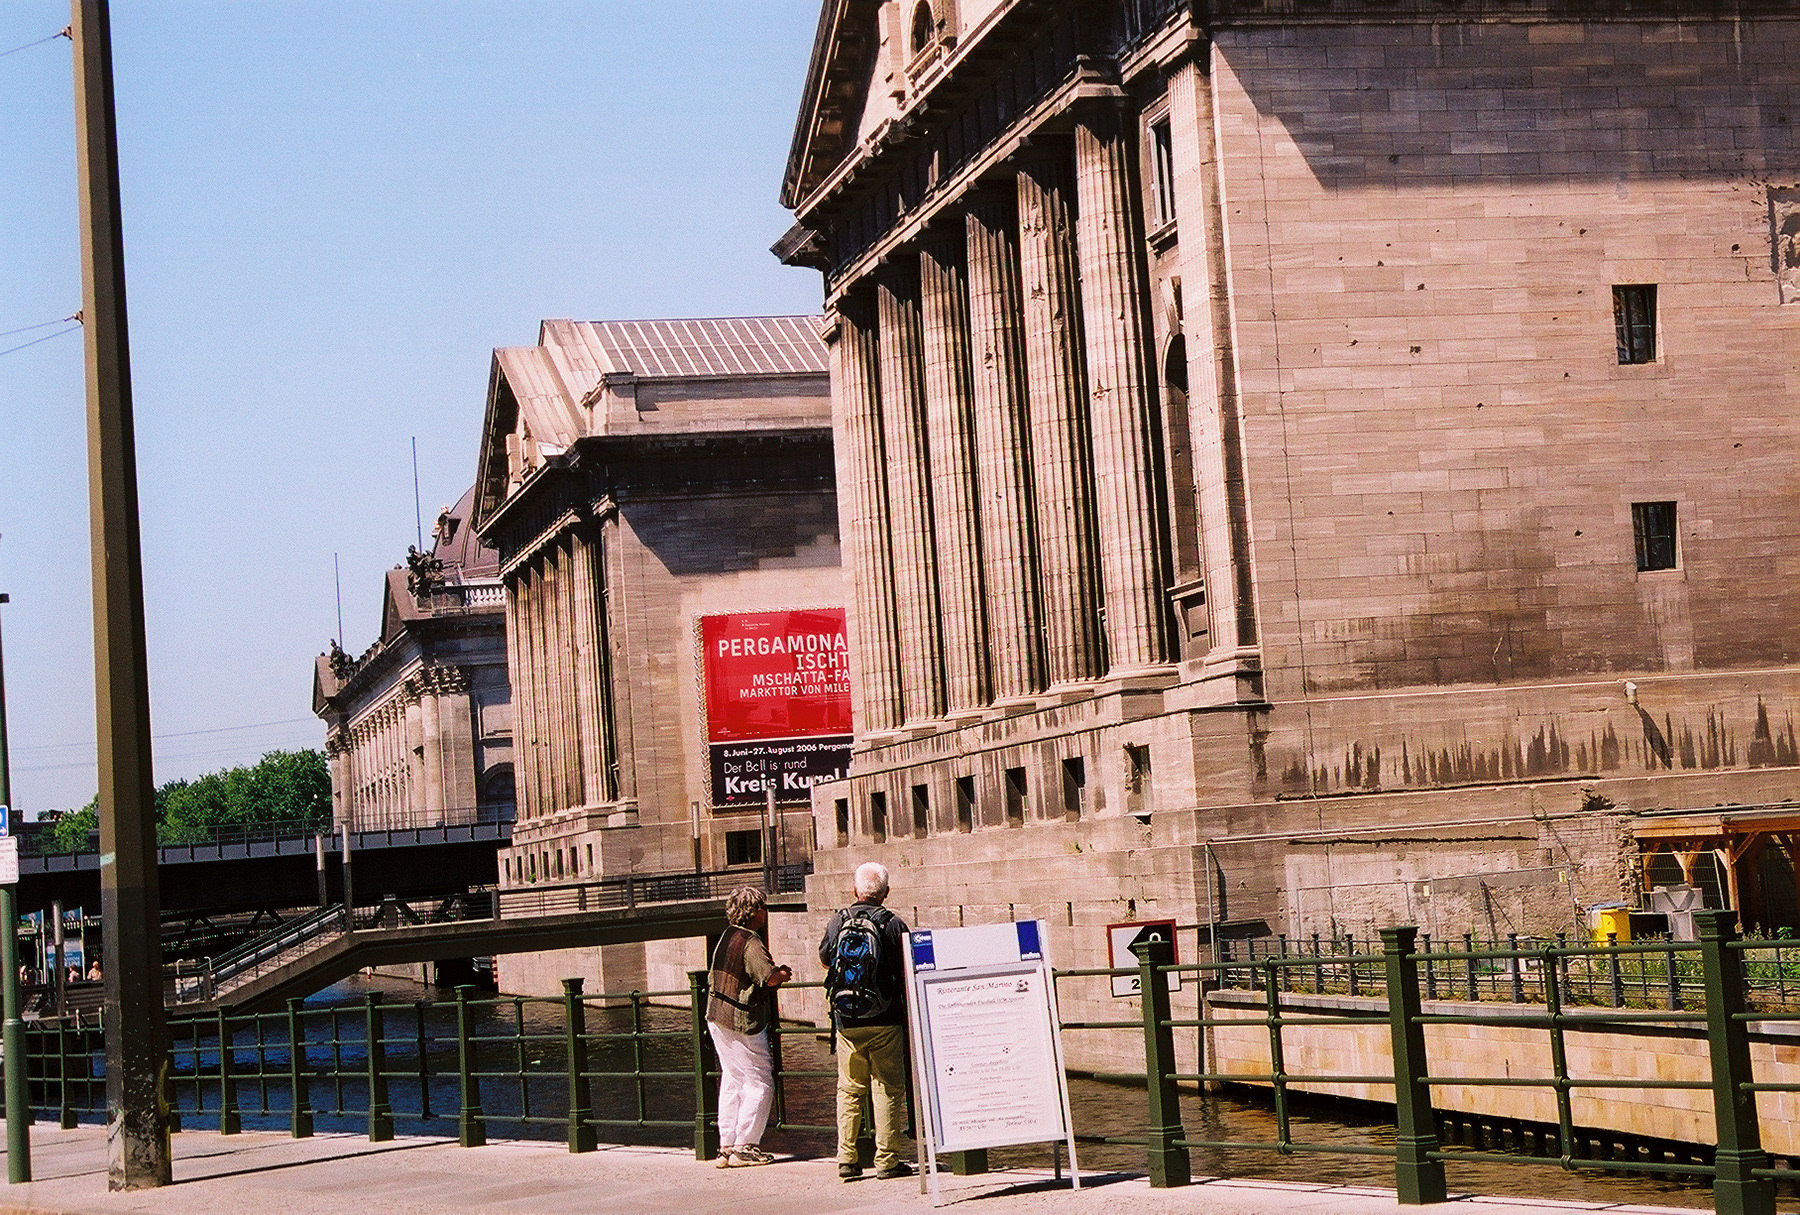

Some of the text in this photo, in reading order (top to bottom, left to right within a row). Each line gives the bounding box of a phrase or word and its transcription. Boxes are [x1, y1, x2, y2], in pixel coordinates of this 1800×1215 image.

[718, 632, 847, 658] PERGAMONA
[795, 651, 849, 670] ISCHT
[752, 669, 851, 687] MSCHATTA-FA
[740, 685, 798, 699] MARKTTOR
[800, 684, 821, 695] VON
[824, 682, 850, 693] MILE
[796, 743, 817, 752] 2006
[724, 762, 742, 774] Der
[784, 757, 807, 769] rund
[725, 773, 777, 794] Kreis
